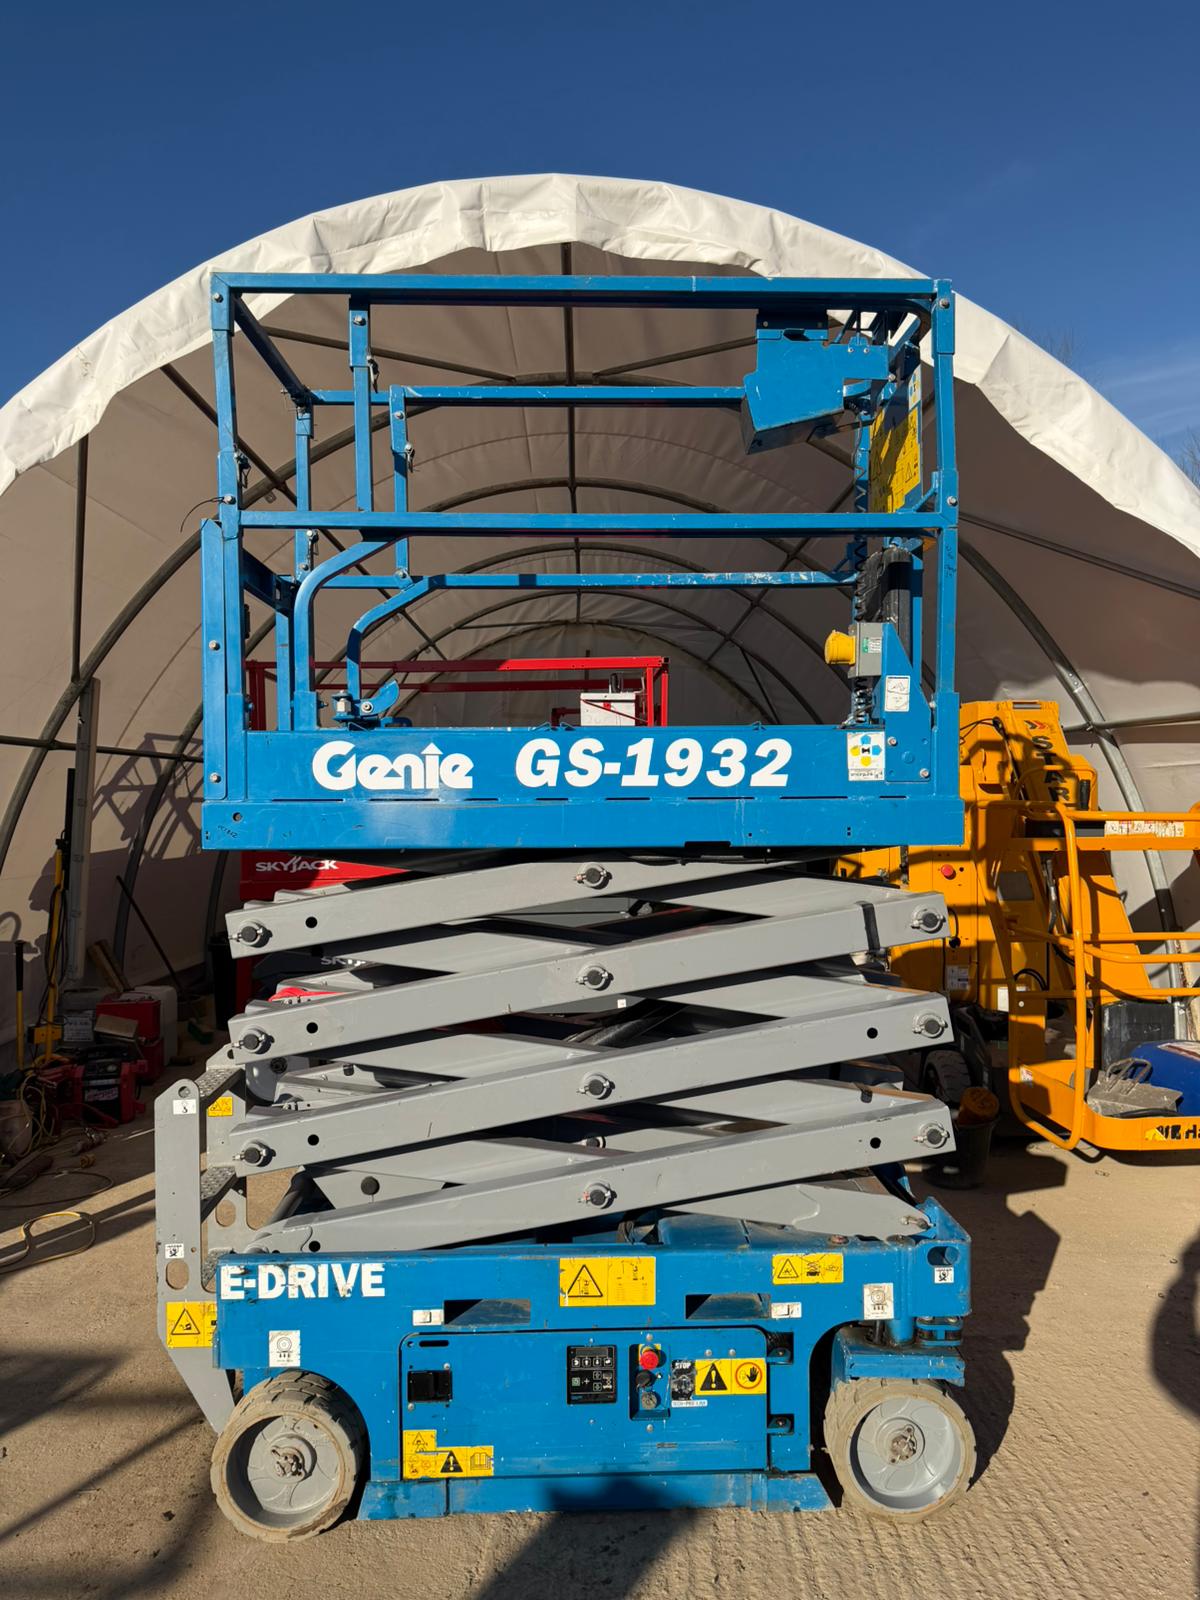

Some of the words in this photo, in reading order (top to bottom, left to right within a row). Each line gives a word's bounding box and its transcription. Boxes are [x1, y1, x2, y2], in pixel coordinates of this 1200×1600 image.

[312, 740, 474, 790] Genie
[515, 738, 793, 788] GS-1932
[1030, 735, 1070, 802] STAR
[255, 856, 339, 873] SKYJACK
[220, 1262, 386, 1299] E-DRIVE
